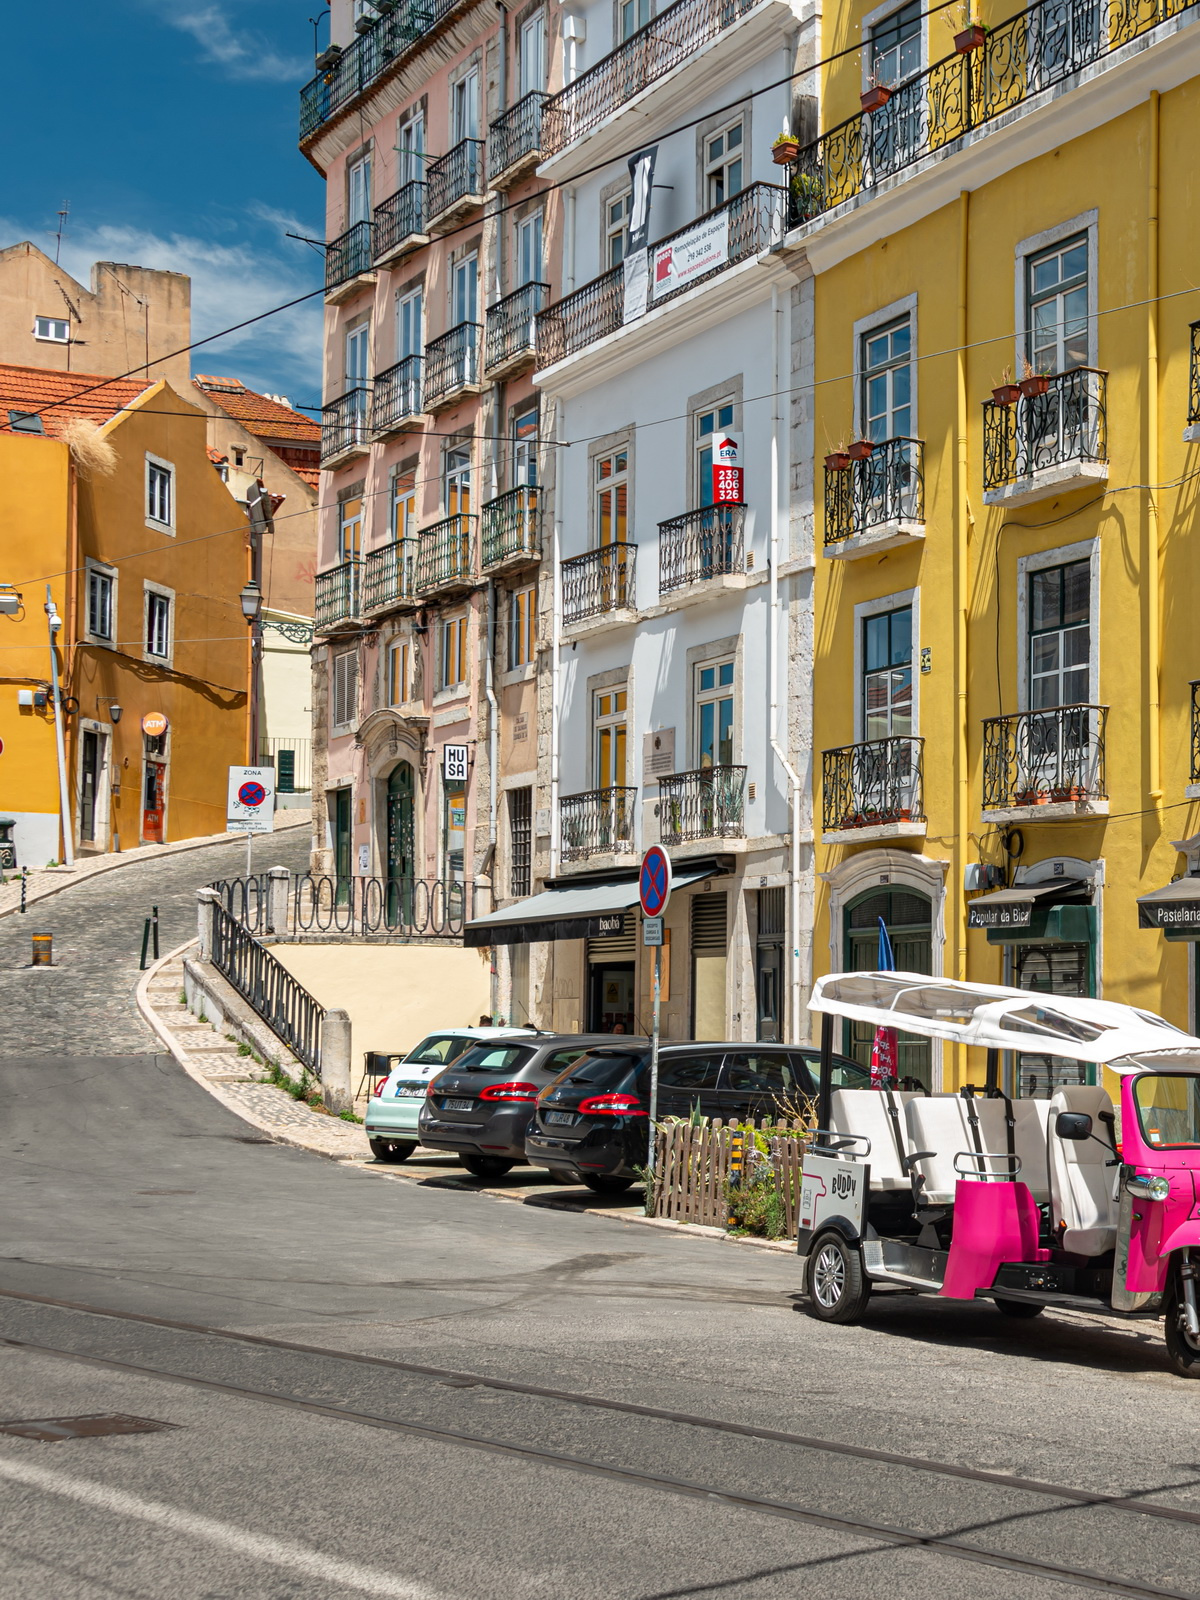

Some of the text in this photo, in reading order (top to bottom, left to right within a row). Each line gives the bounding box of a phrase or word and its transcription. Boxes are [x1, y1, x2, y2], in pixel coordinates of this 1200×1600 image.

[720, 449, 737, 457] ERA
[719, 470, 739, 480] 239
[719, 480, 739, 489] 406
[719, 490, 739, 500] 326
[145, 720, 165, 728] ATM
[448, 763, 464, 777] SA
[971, 908, 1029, 926] Popular da Bica
[832, 1173, 857, 1197] BUDDY
